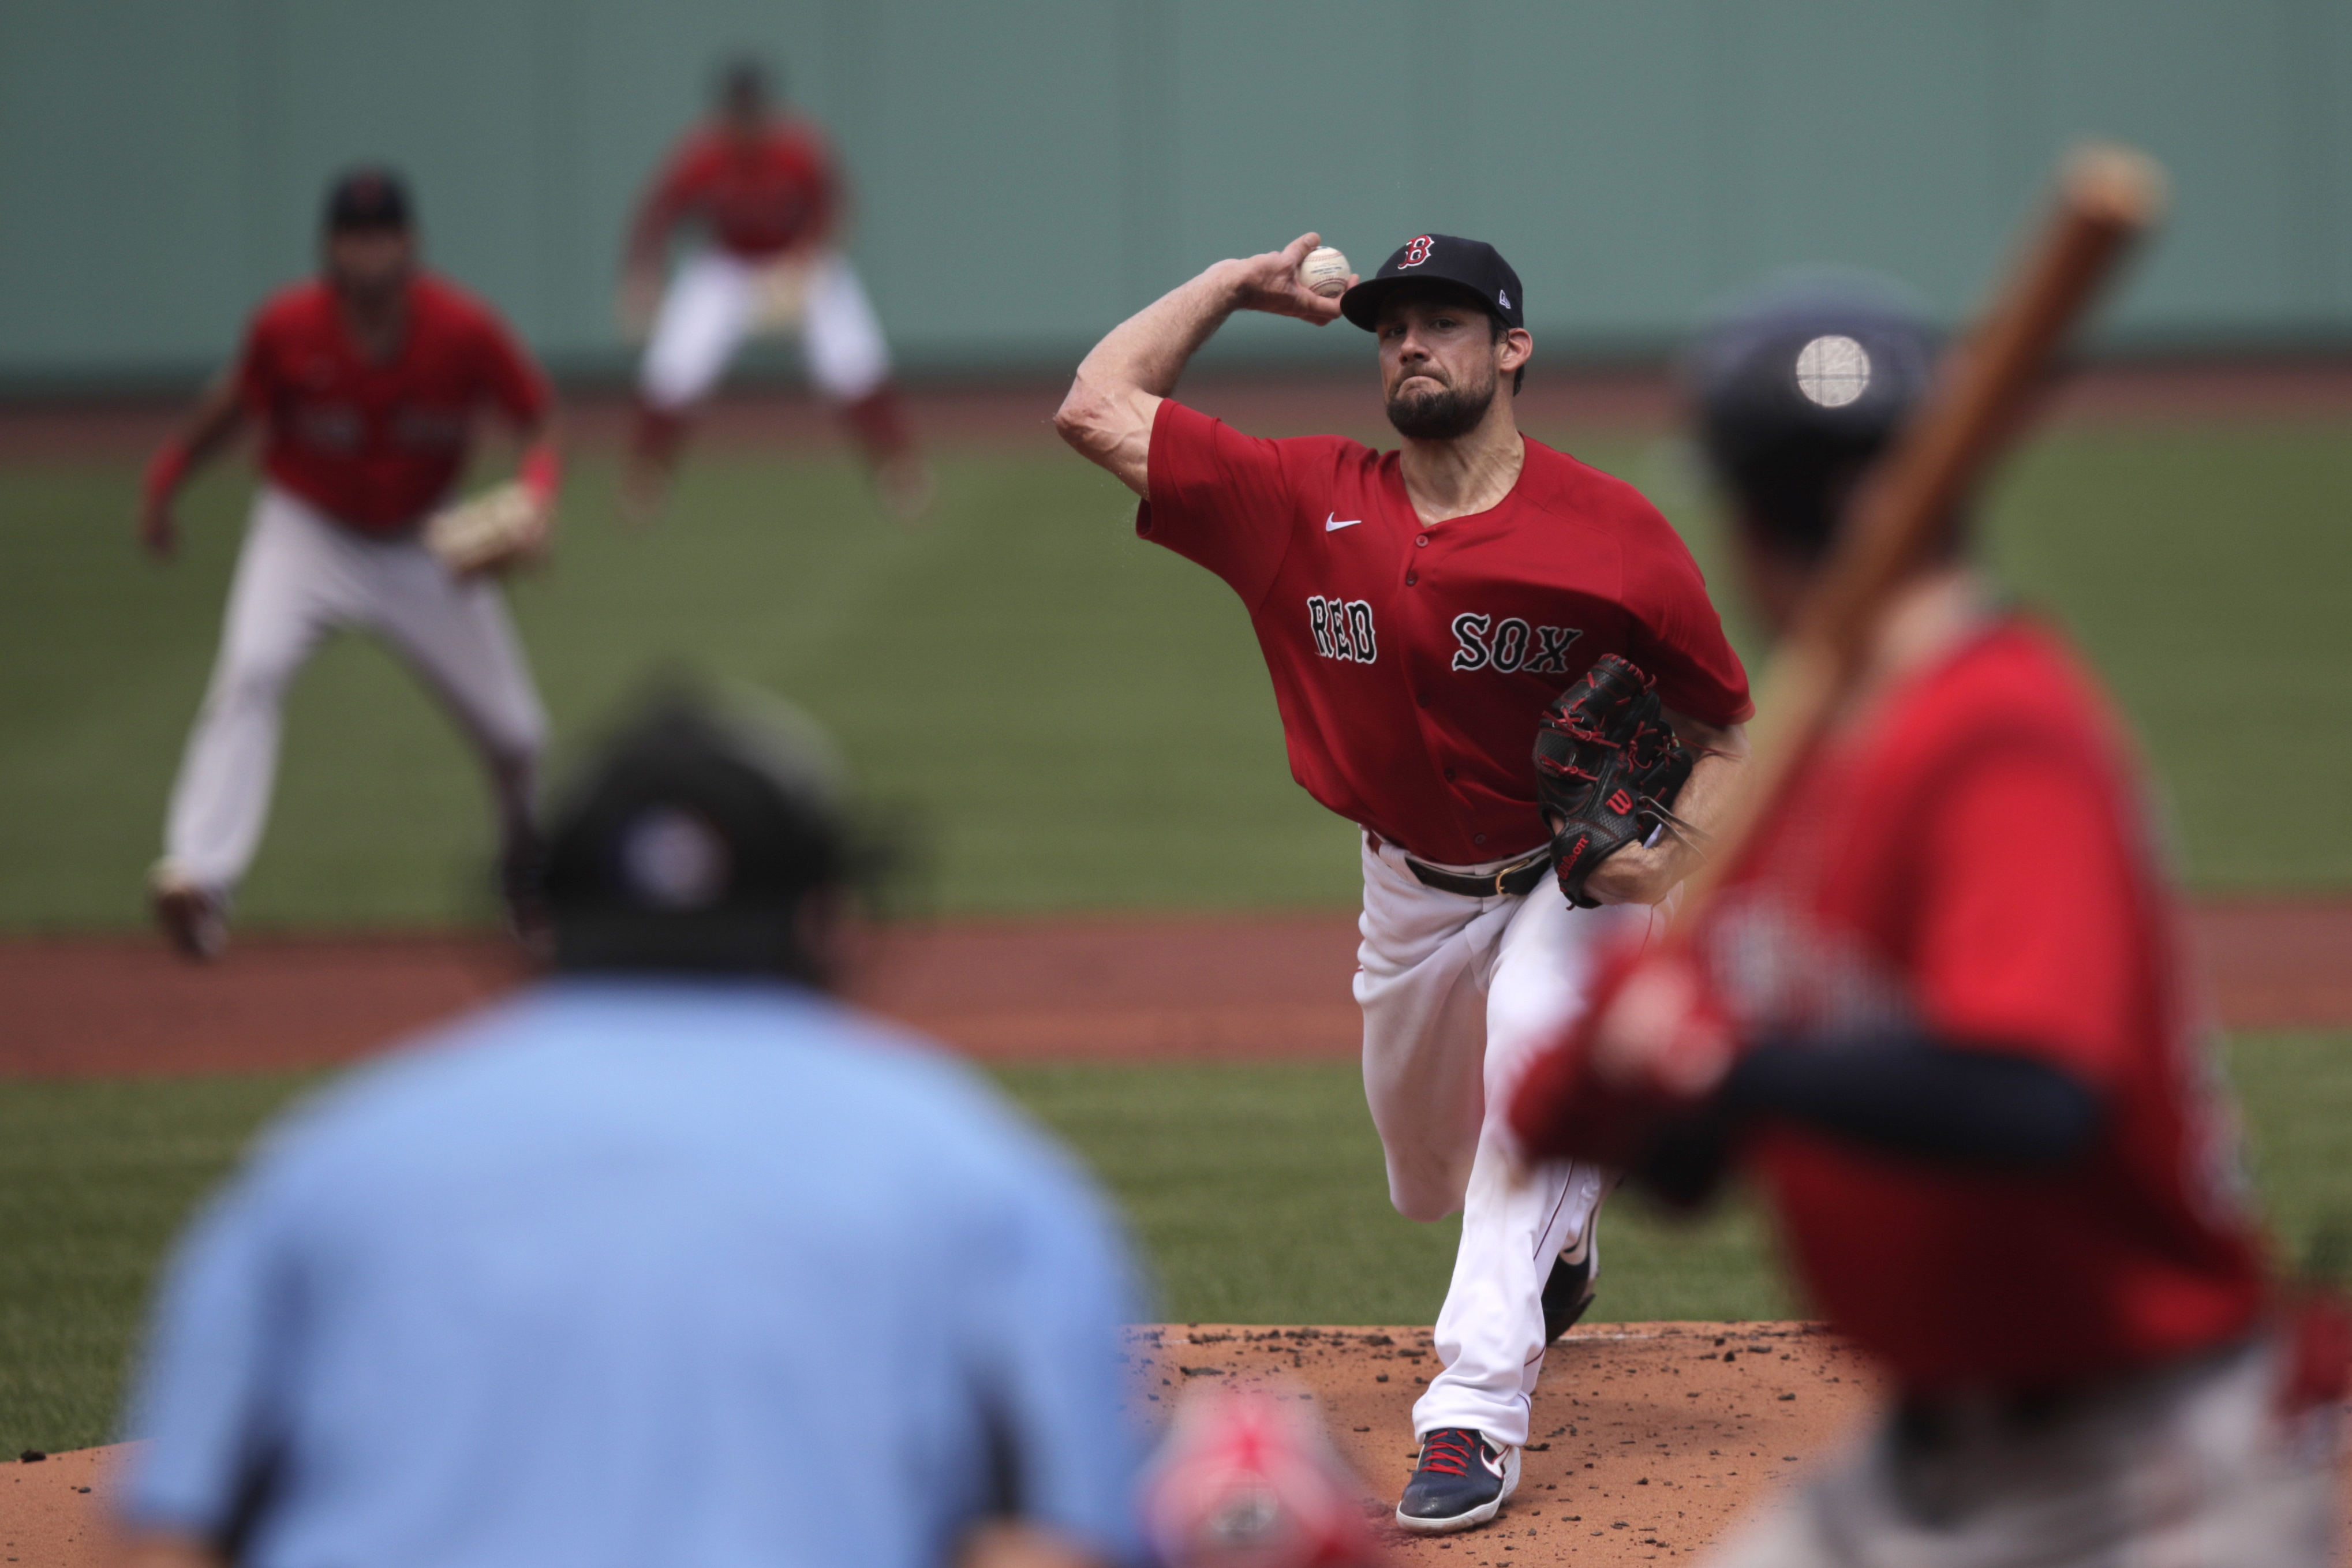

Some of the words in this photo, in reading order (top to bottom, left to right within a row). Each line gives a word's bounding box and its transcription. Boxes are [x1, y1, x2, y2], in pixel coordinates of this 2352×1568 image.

[1397, 235, 1434, 270] B
[1307, 595, 1377, 664] RED
[1451, 612, 1584, 673] SOX
[1557, 837, 1589, 880] Wilson
